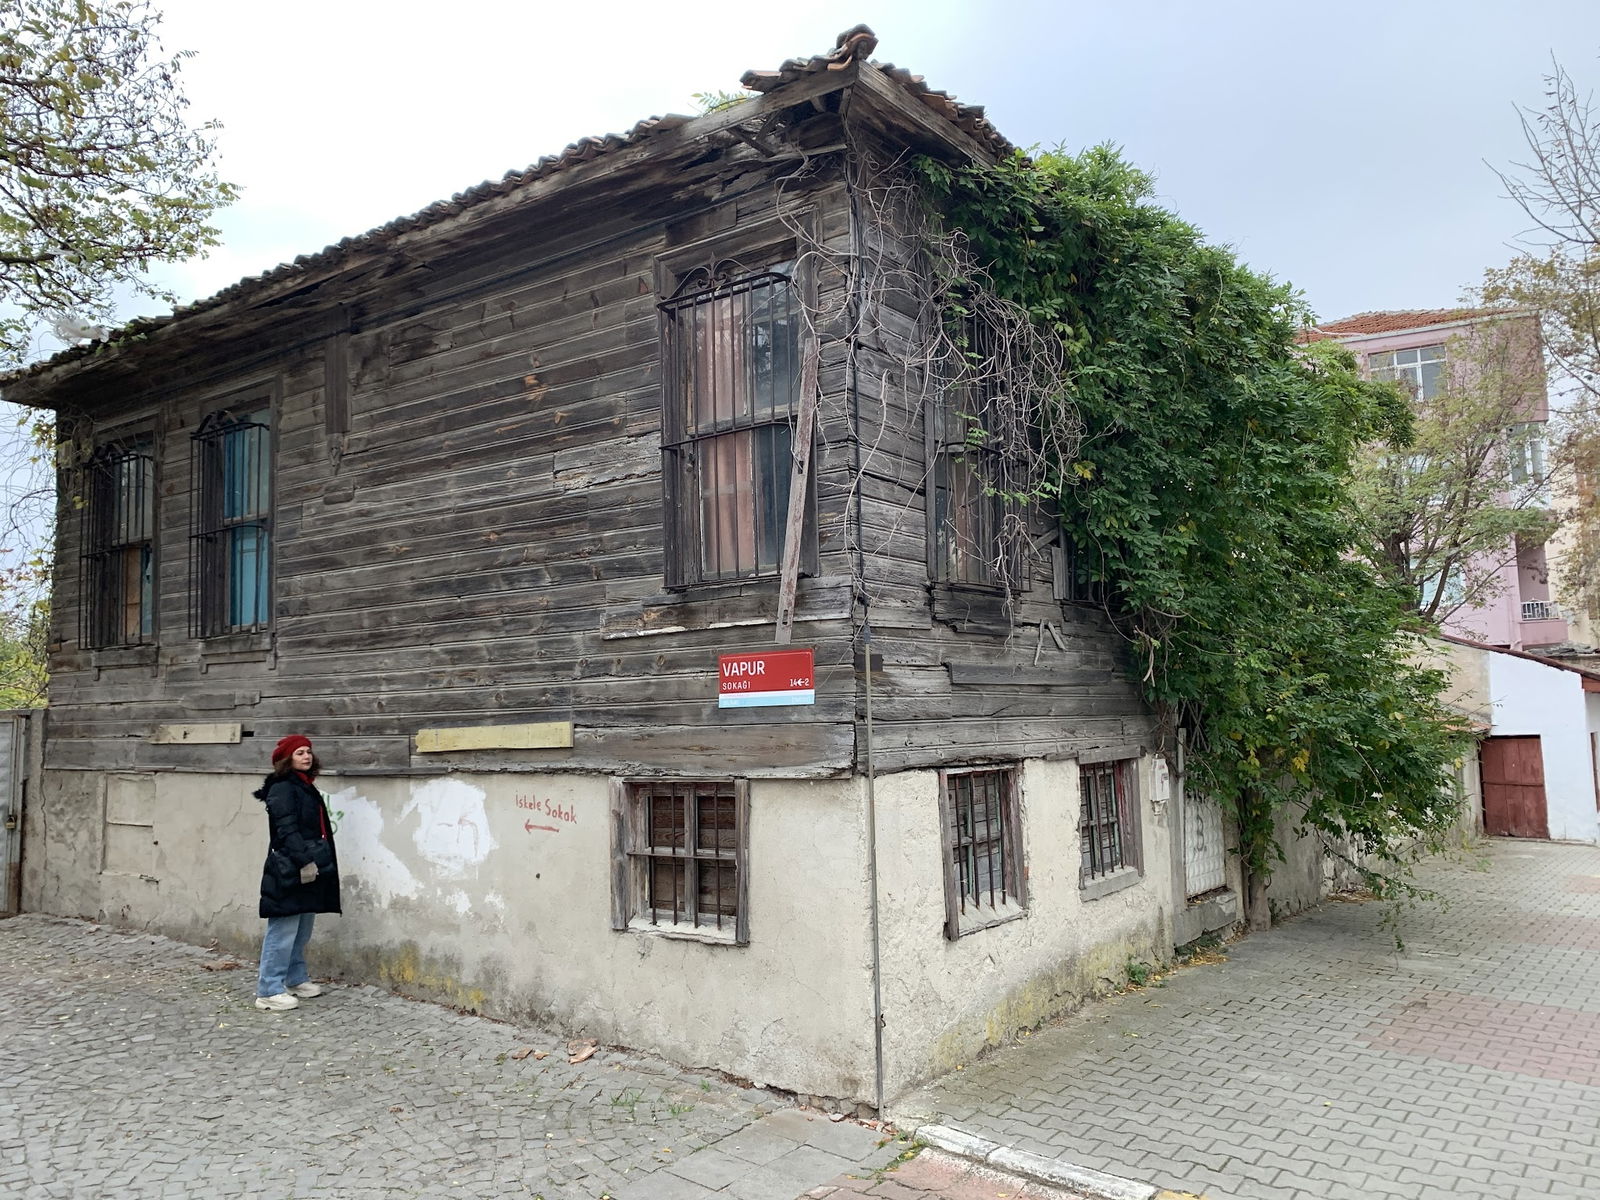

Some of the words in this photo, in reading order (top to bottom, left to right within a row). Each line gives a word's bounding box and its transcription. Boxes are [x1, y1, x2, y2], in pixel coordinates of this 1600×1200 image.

[722, 660, 766, 677] VAPUR
[722, 680, 751, 691] SOKAĞI
[544, 798, 578, 824] Sokak
